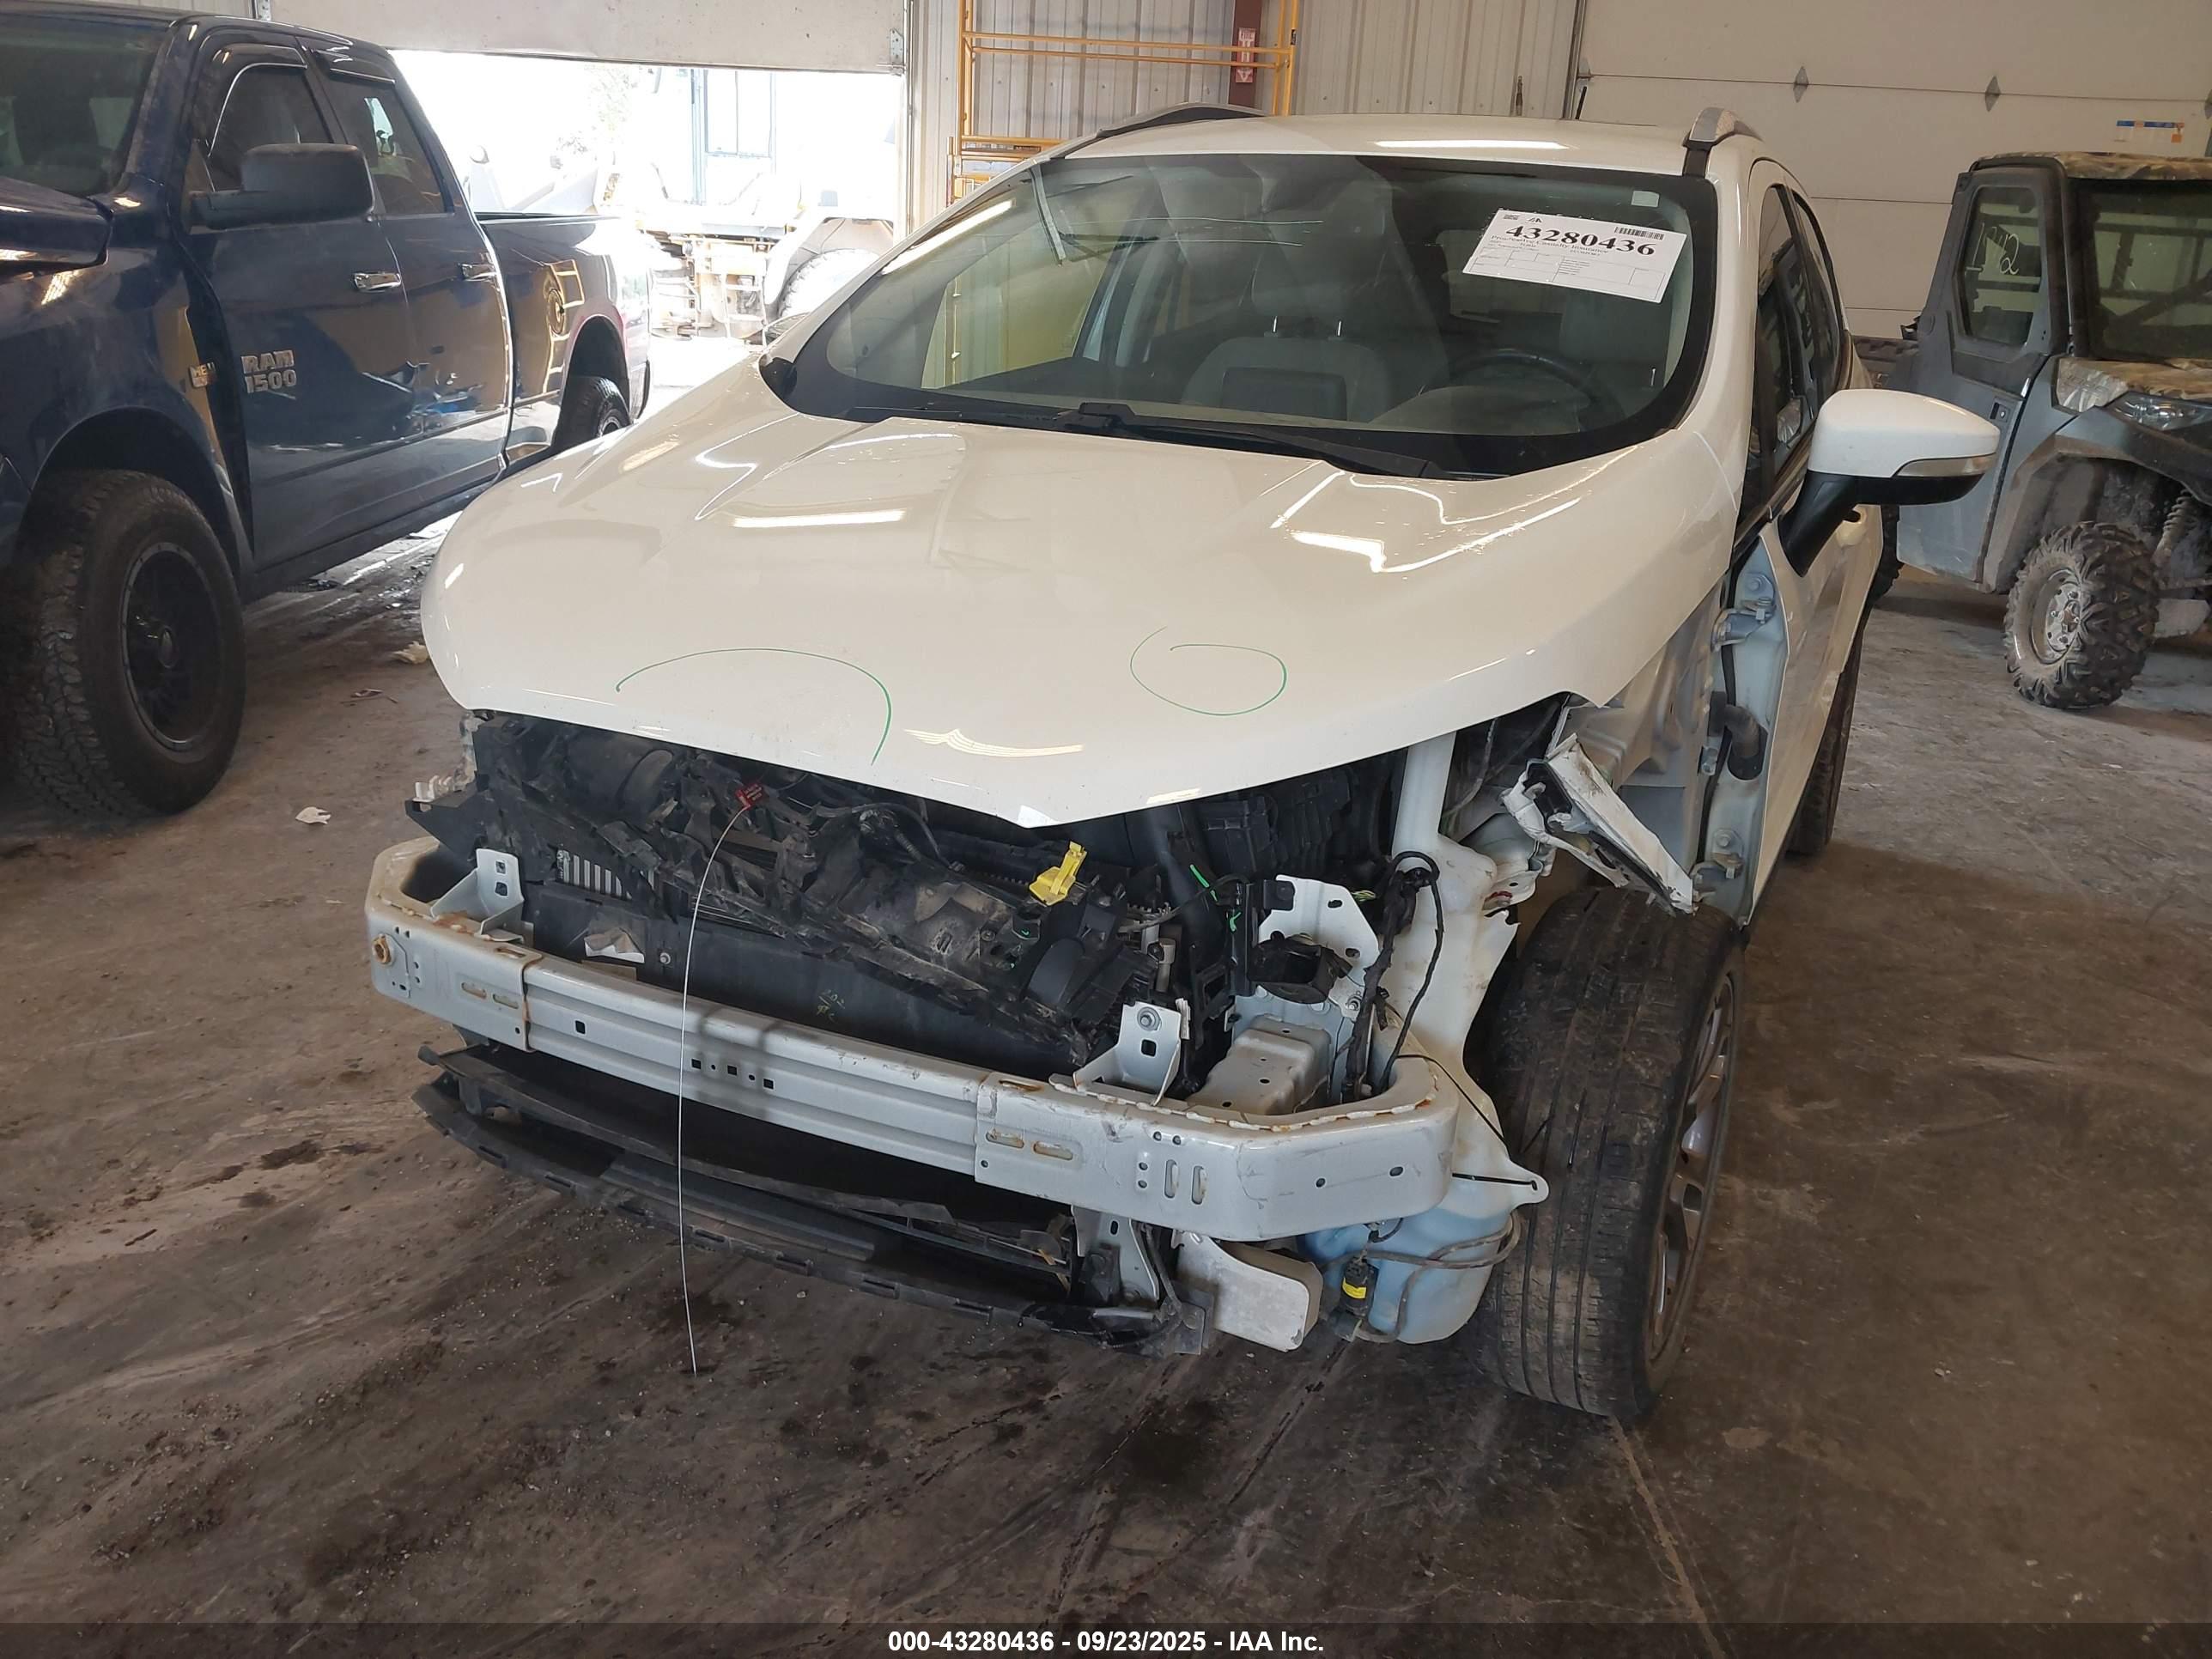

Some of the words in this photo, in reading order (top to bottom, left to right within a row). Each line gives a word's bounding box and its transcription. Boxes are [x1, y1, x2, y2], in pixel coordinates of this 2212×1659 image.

[1505, 225, 1656, 256] 43280436
[241, 349, 295, 374] RAM
[245, 369, 297, 393] 1500
